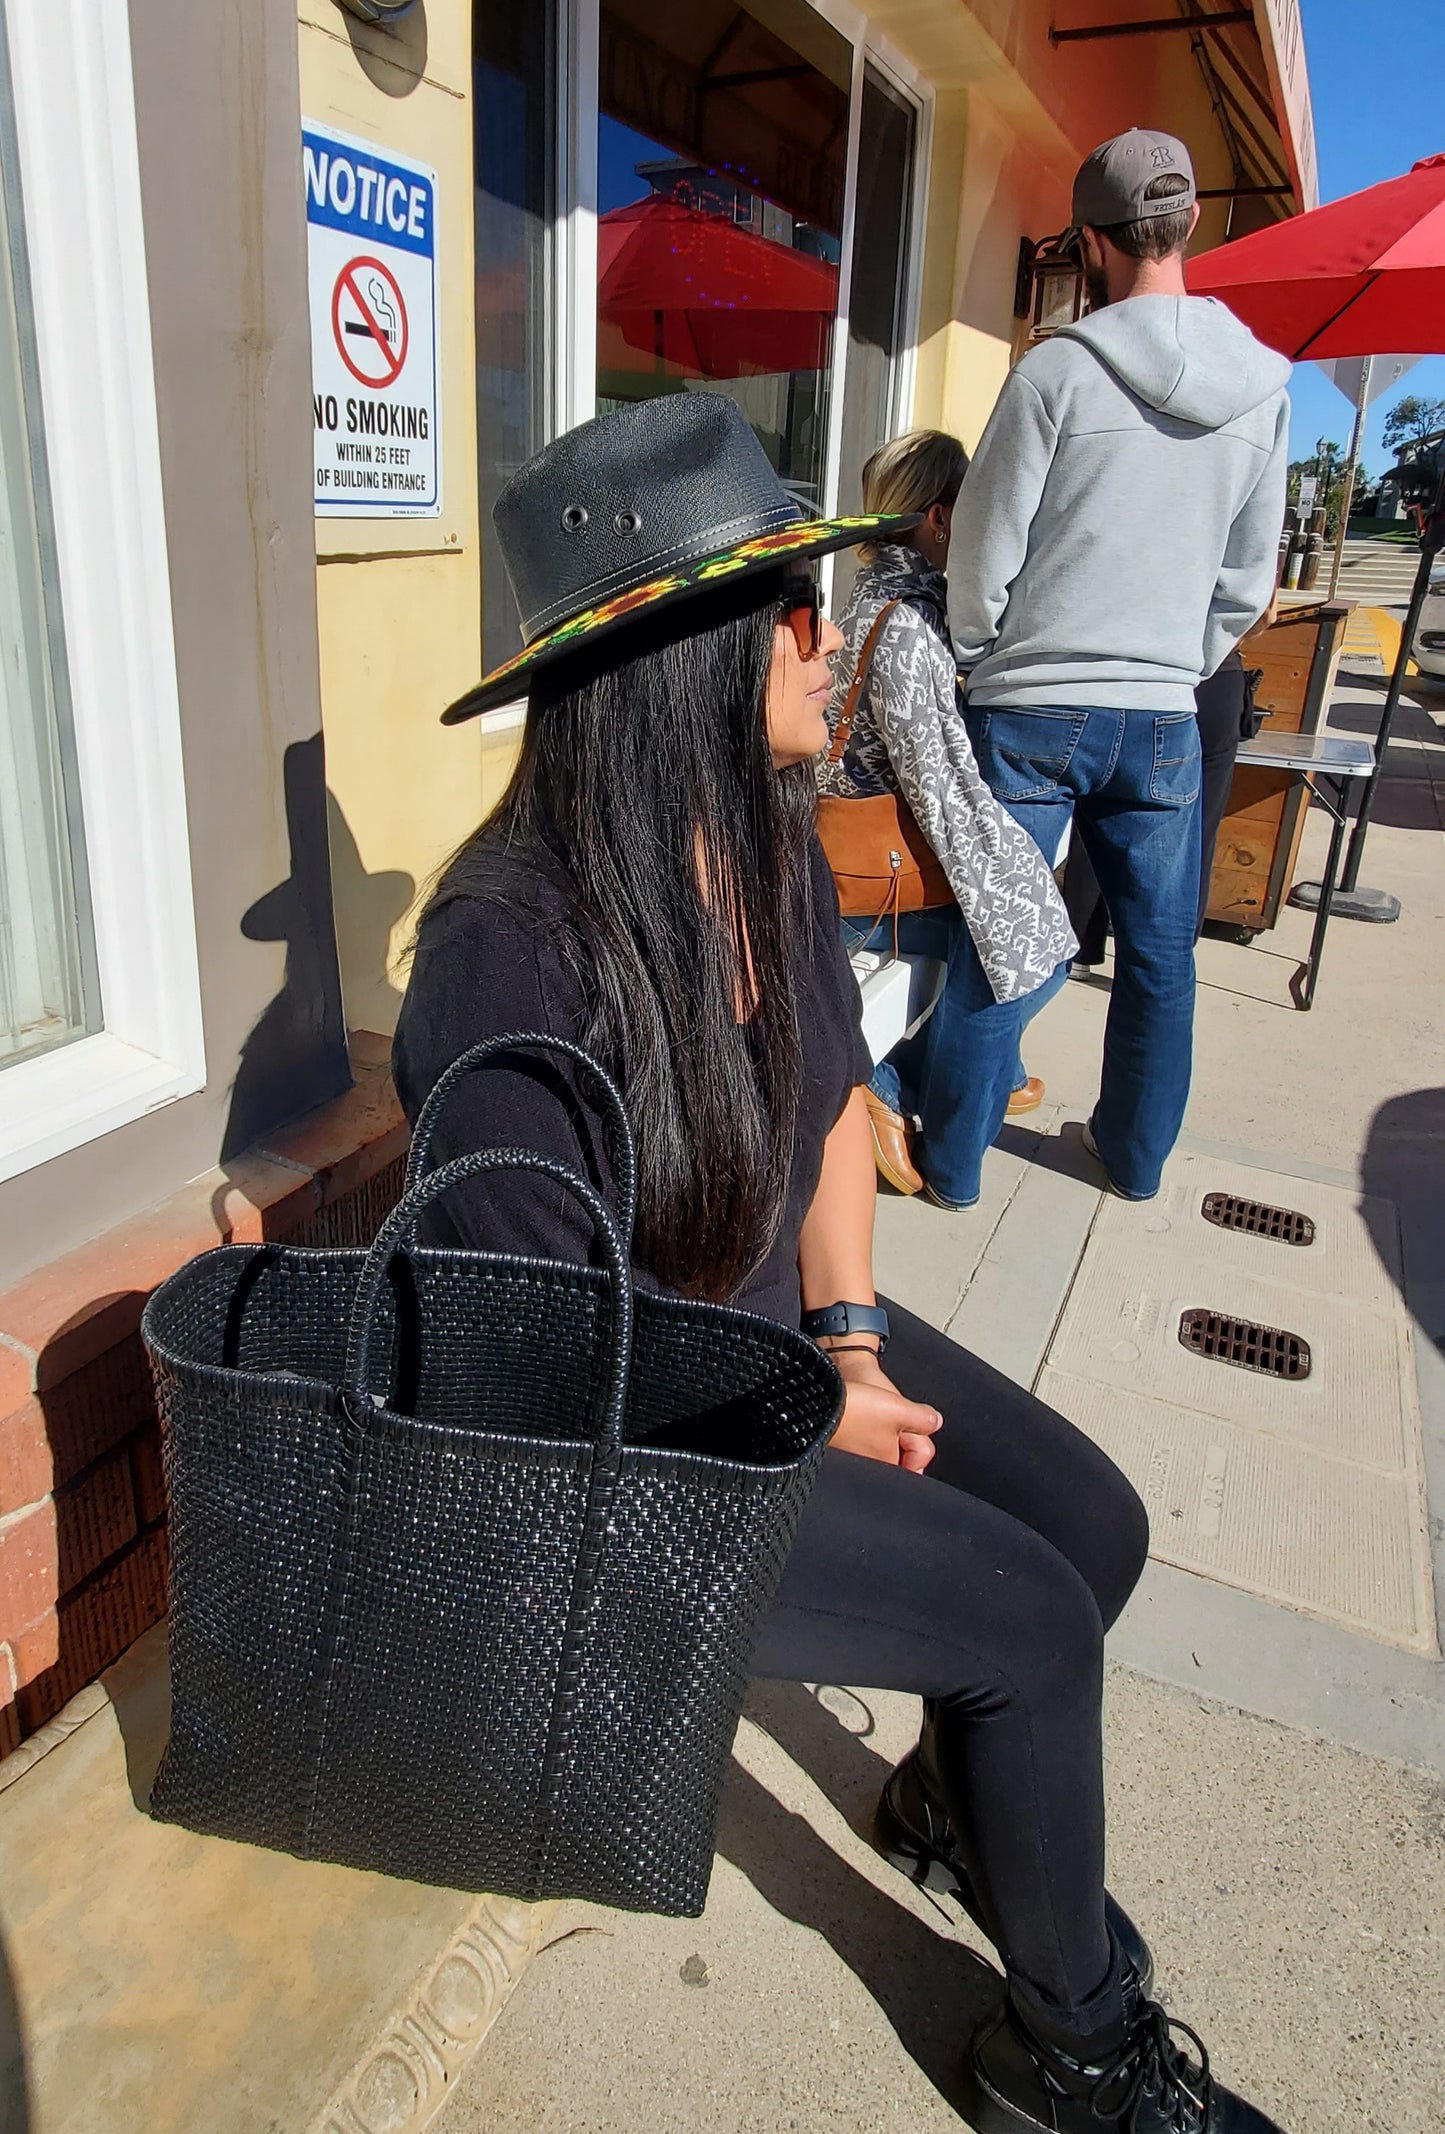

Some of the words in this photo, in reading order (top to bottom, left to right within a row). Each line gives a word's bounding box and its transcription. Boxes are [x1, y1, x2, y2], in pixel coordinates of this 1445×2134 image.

[303, 146, 427, 239] NOTICE
[313, 394, 339, 431] NO
[346, 398, 429, 440] SMOKING
[336, 443, 372, 463] WITHIN
[375, 446, 387, 464] 25
[389, 447, 411, 466] FEET
[316, 468, 331, 487] OF
[334, 469, 379, 489] BUILDING
[382, 472, 426, 491] ENTRANCE
